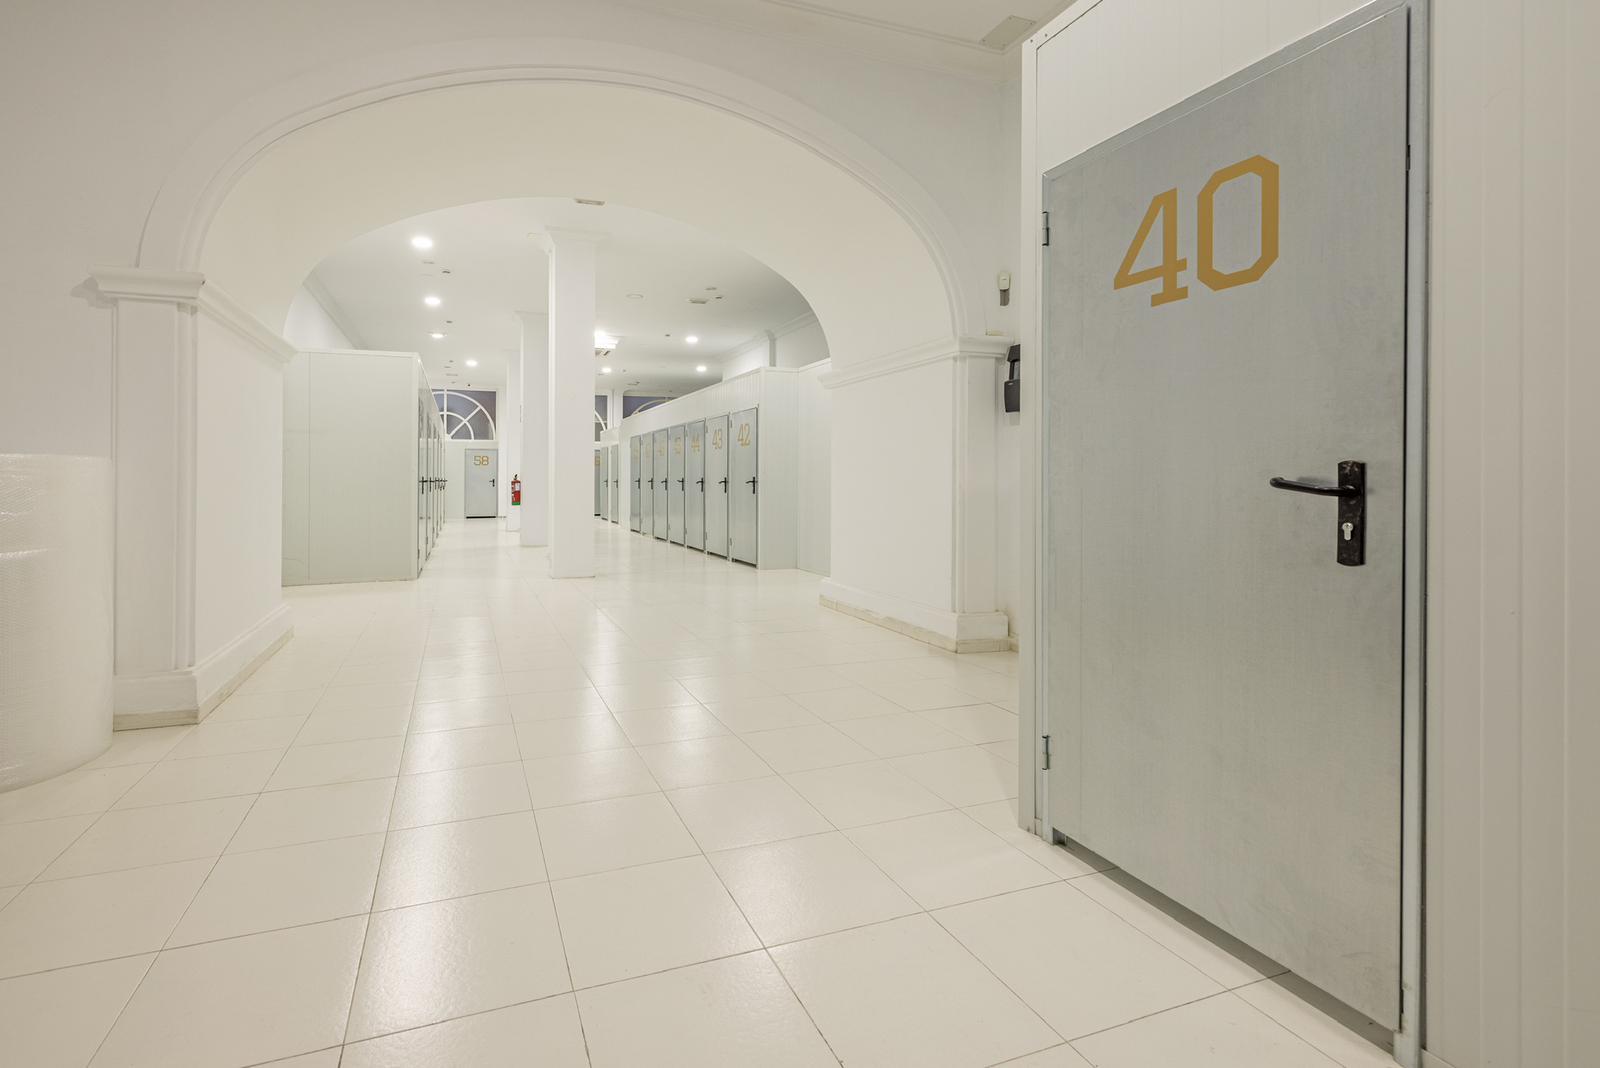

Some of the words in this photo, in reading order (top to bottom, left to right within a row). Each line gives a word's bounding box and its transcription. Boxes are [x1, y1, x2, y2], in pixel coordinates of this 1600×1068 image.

[1113, 154, 1280, 308] 40
[712, 428, 723, 450] 43
[737, 423, 751, 447] 42
[474, 455, 490, 467] 58
